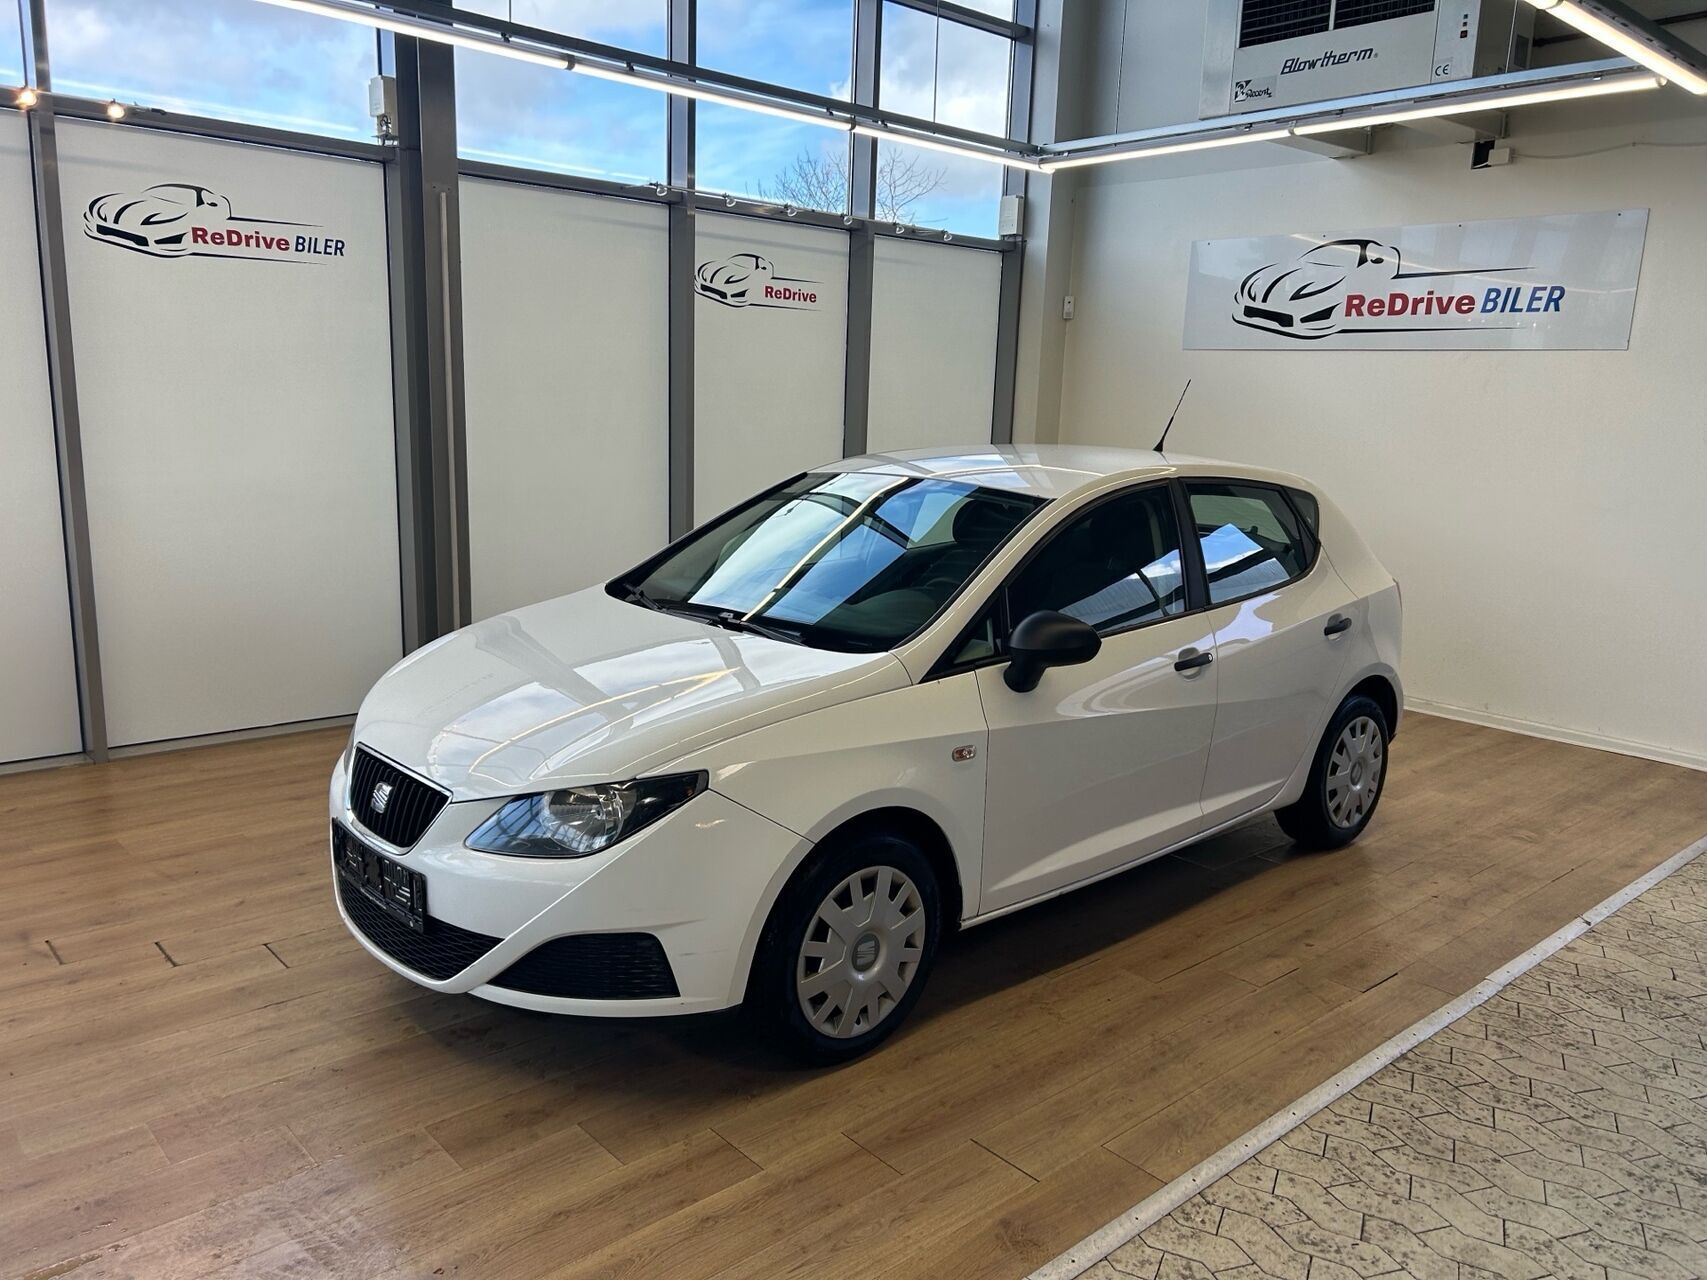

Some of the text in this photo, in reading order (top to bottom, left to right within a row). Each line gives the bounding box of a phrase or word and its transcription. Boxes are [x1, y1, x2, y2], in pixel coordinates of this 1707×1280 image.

[1280, 48, 1374, 75] Blowtherm
[1435, 64, 1450, 76] CE
[191, 226, 346, 257] ReDrive BILER
[764, 285, 817, 303] ReDrive
[1344, 285, 1566, 317] ReDrive BILER
